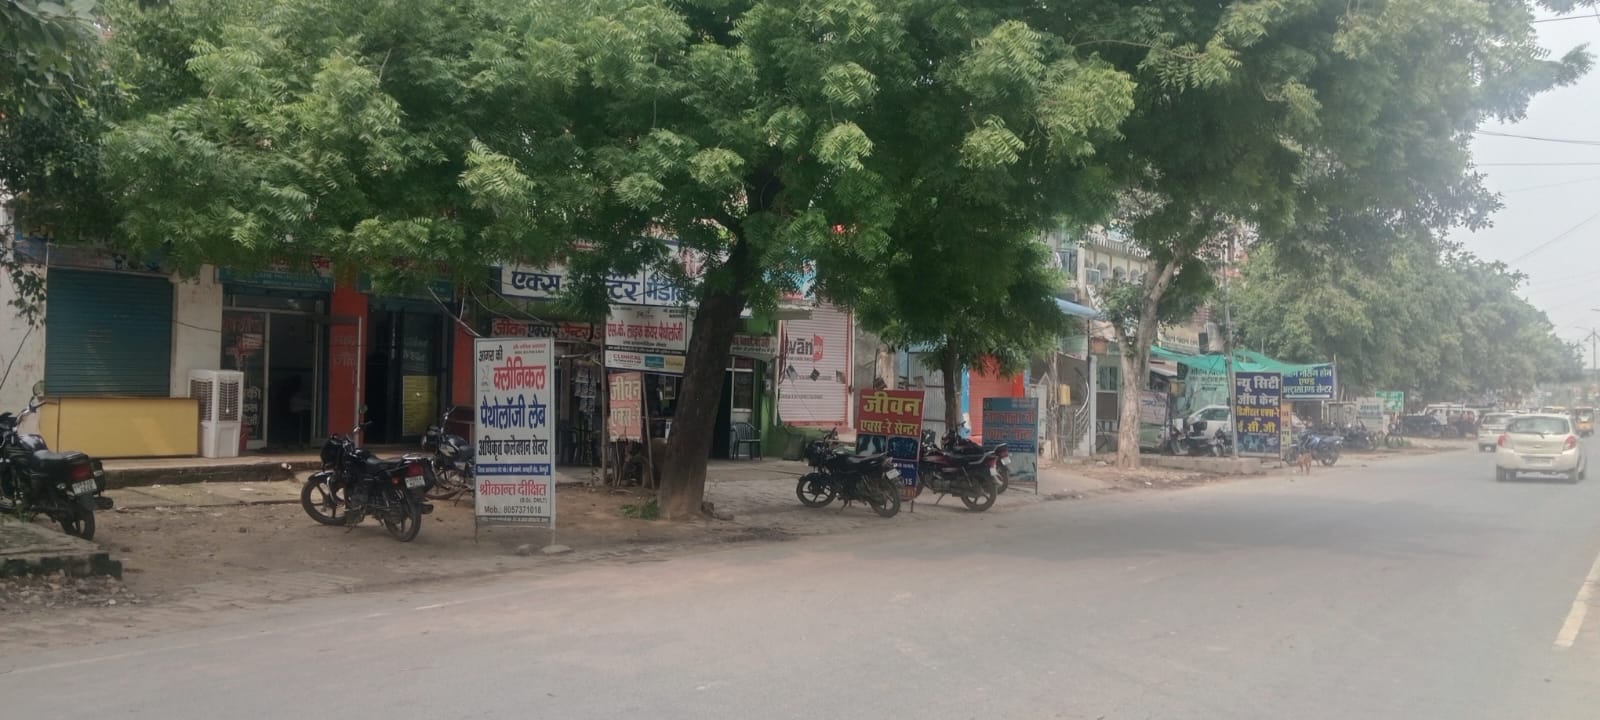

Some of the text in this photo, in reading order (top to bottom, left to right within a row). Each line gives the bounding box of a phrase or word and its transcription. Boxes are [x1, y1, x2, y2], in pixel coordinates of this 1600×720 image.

[493, 355, 547, 391] क्लीनिकल
[1236, 377, 1252, 392] न्यू
[1253, 375, 1280, 389] सिटी
[480, 393, 546, 429] पैथोलॉजी लैब
[862, 391, 922, 416] जीवन
[478, 435, 503, 460] अधिकृत
[480, 480, 547, 497] श्रीकान्त दीक्षित
